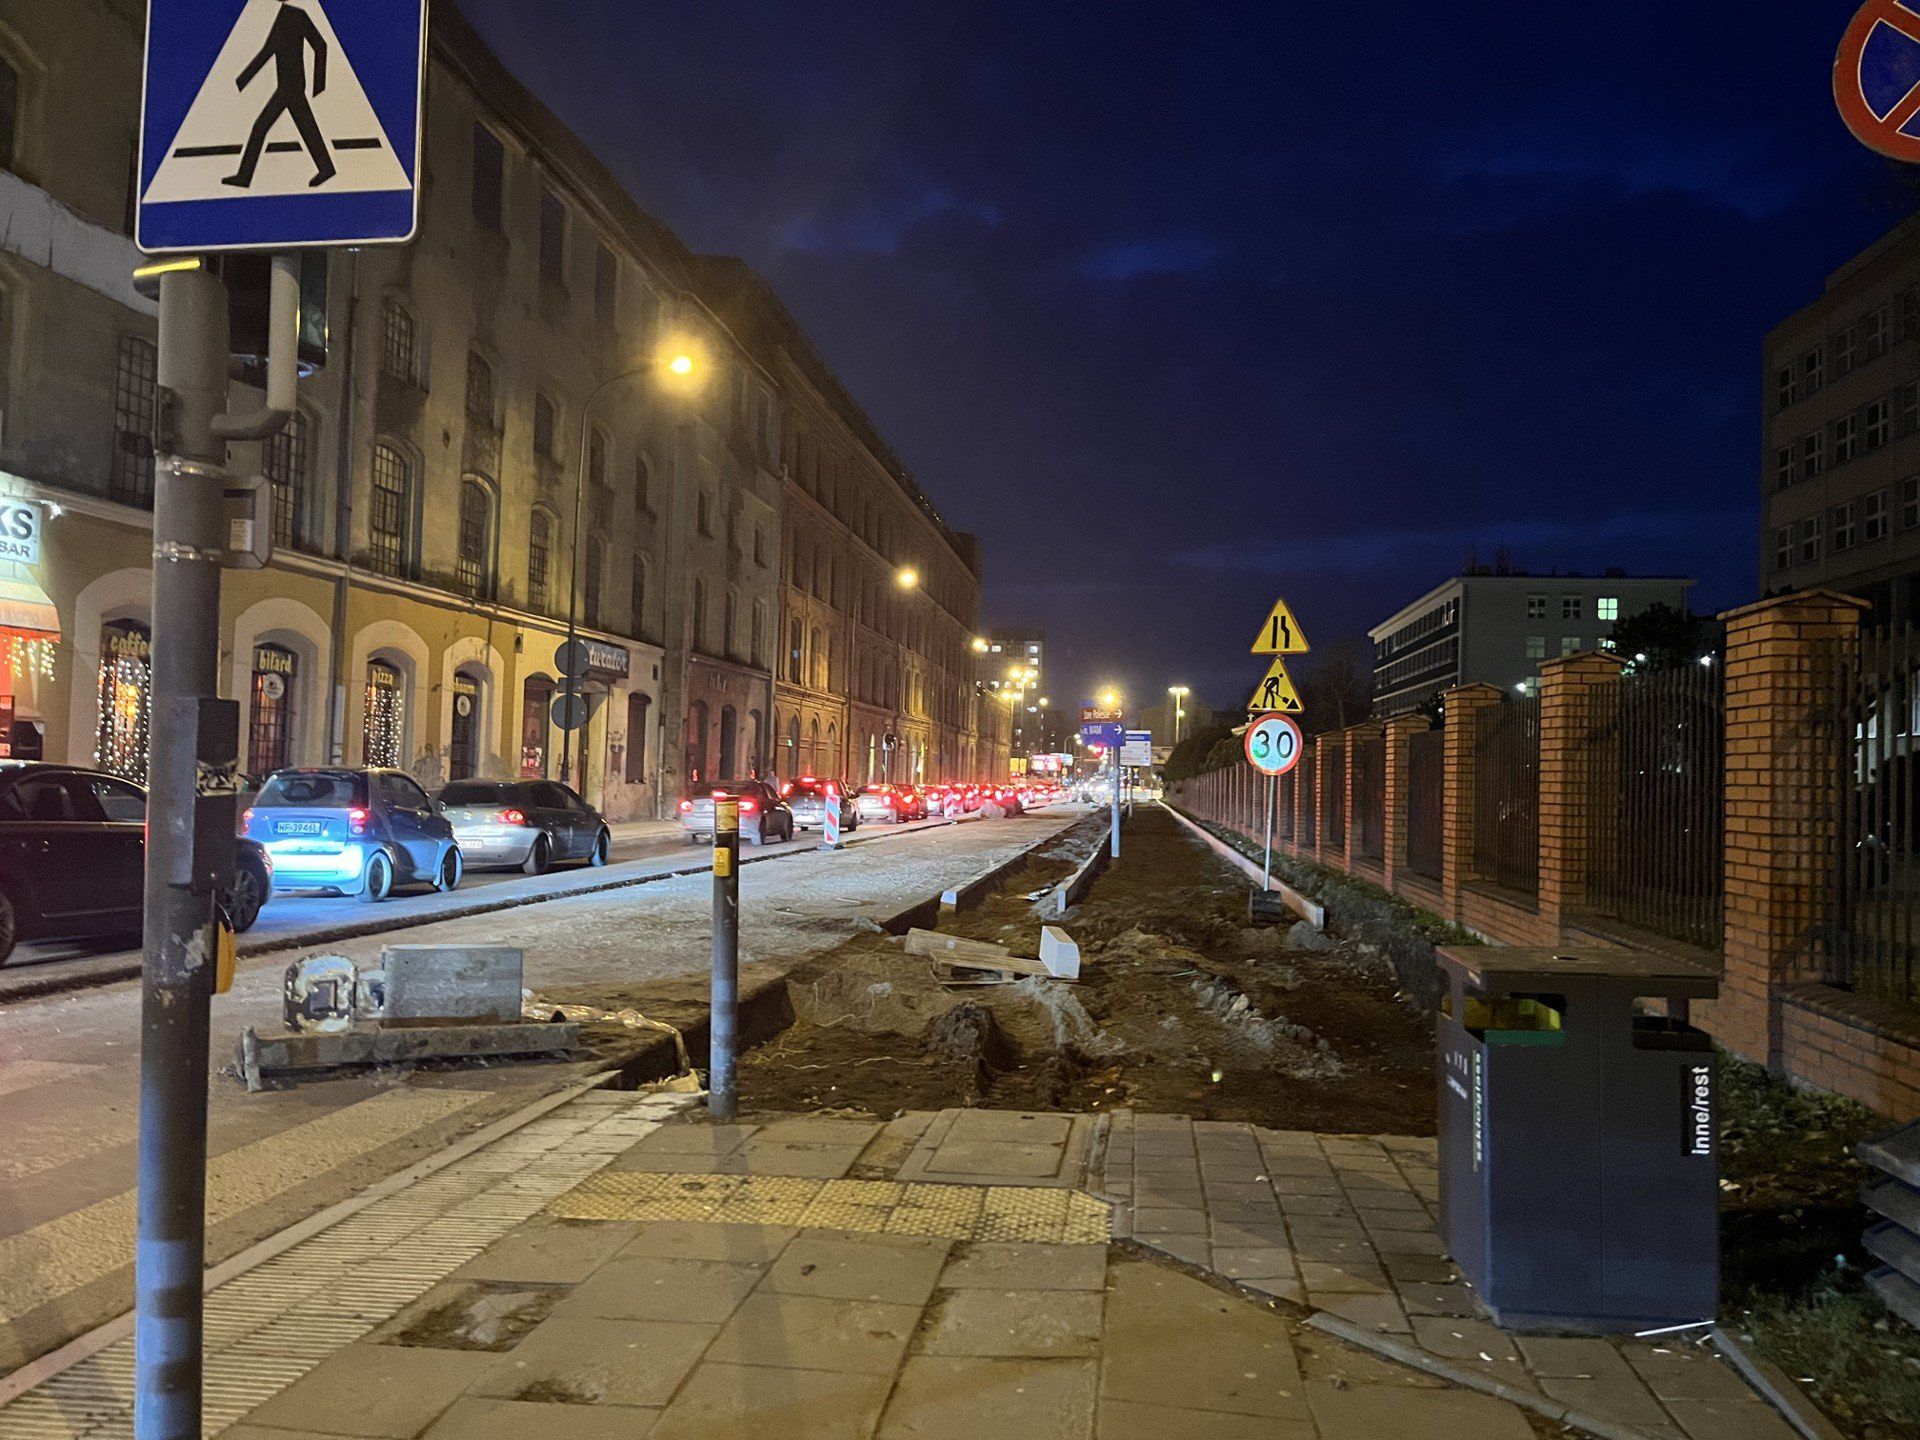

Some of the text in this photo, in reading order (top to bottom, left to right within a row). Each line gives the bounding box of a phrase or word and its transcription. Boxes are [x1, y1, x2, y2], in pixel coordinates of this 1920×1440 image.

[259, 649, 291, 673] bilard
[1253, 729, 1293, 758] 30
[1691, 1066, 1711, 1155] Inne/rest
